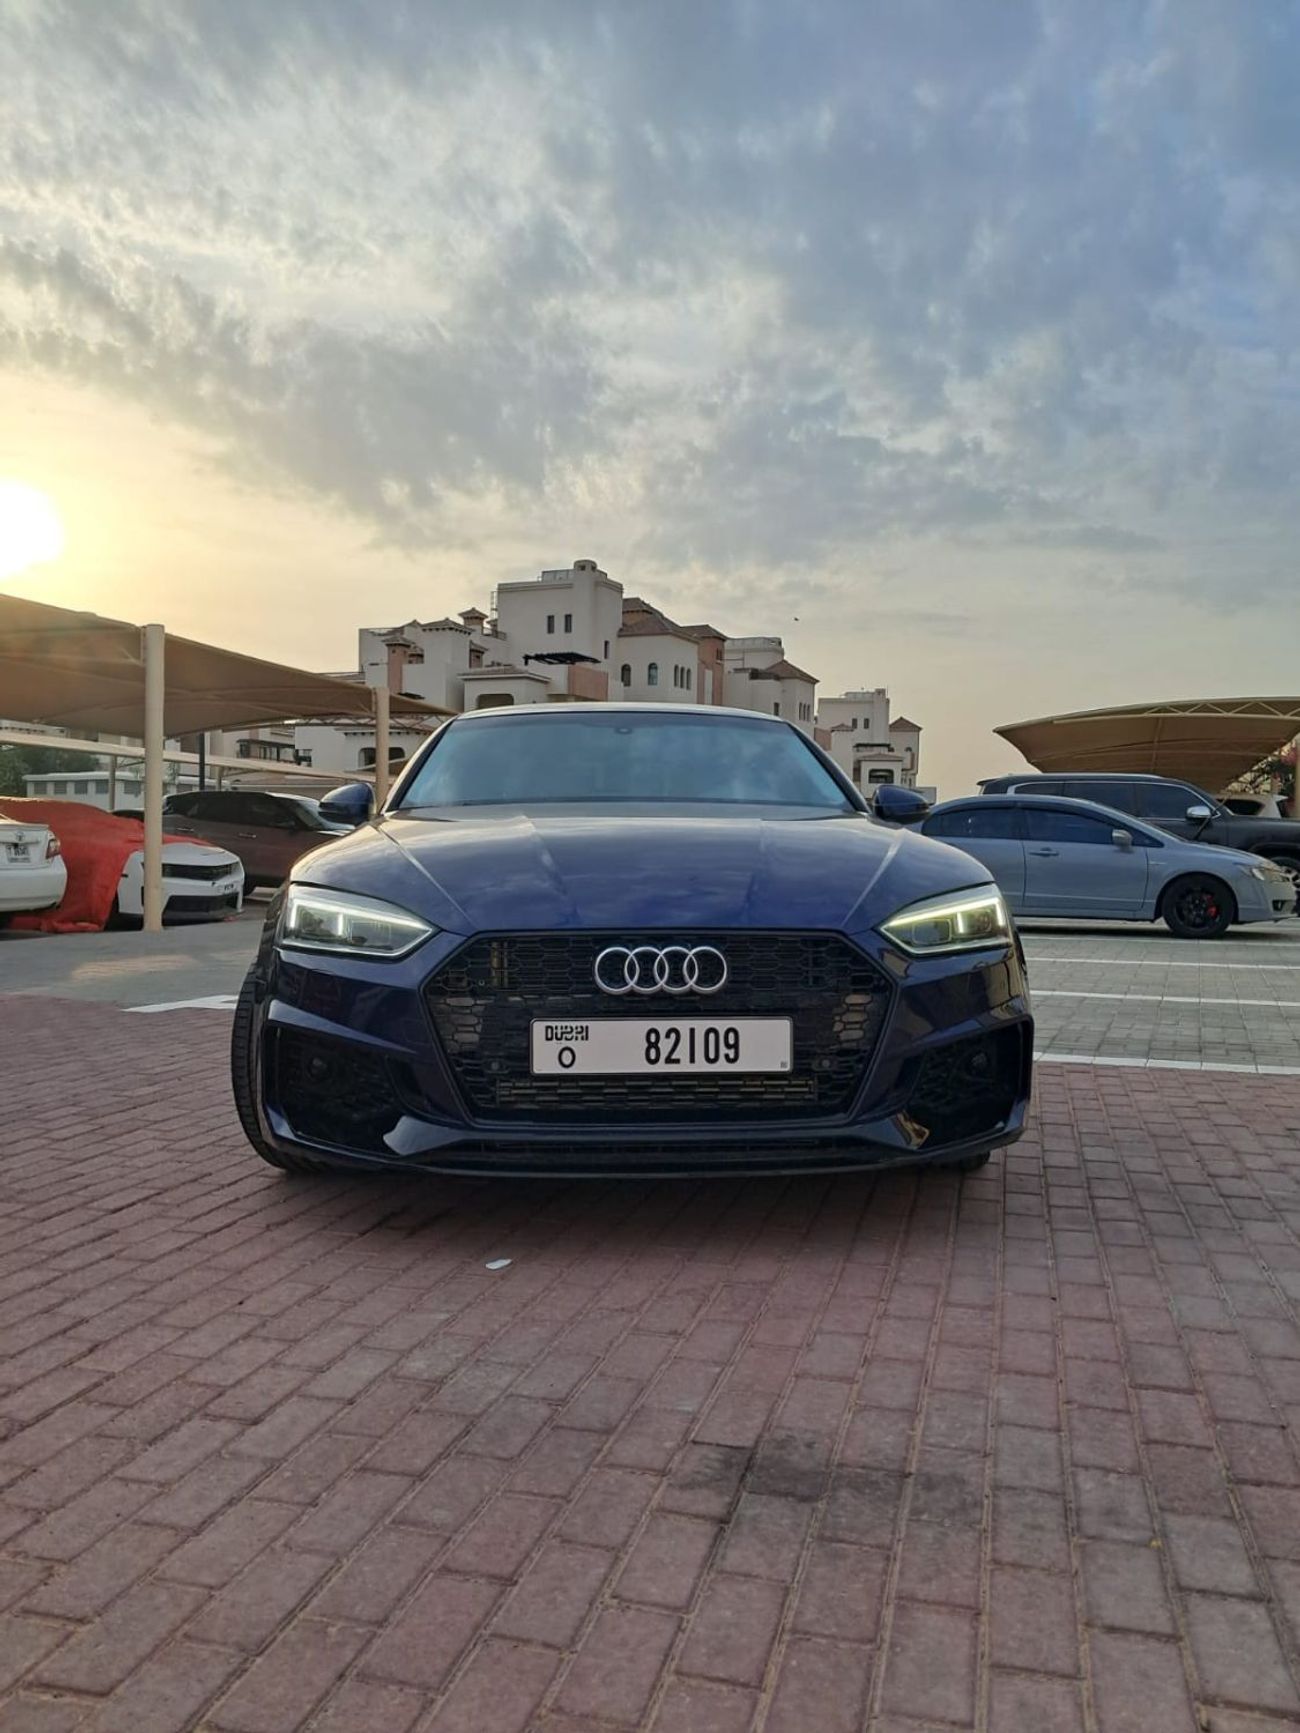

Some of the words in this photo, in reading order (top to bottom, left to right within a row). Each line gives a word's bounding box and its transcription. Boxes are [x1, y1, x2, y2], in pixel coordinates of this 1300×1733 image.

[545, 1025, 589, 1041] DUBAI
[558, 1046, 576, 1069] O
[645, 1027, 740, 1065] 82109
